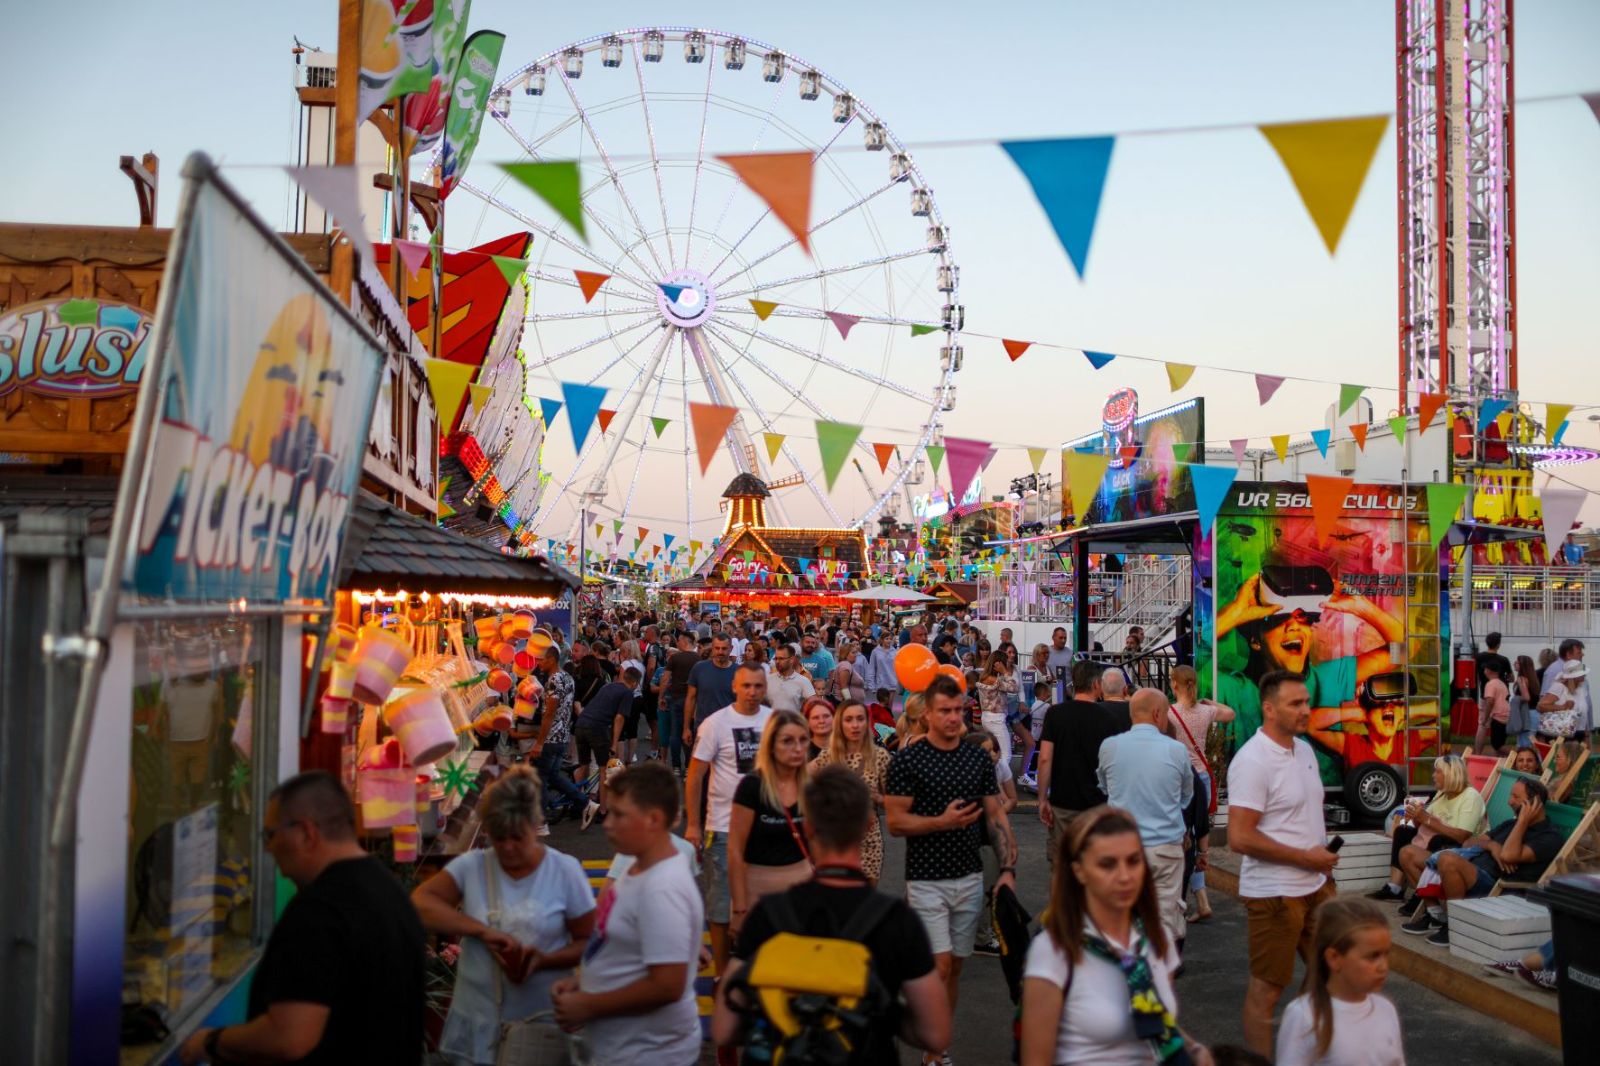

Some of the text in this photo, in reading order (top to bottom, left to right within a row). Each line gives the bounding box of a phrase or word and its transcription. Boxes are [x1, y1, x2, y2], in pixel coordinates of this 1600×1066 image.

[1237, 492, 1269, 508] VR
[1342, 494, 1417, 510] CULUS
[728, 557, 761, 575] Gory
[818, 558, 848, 574] Wta
